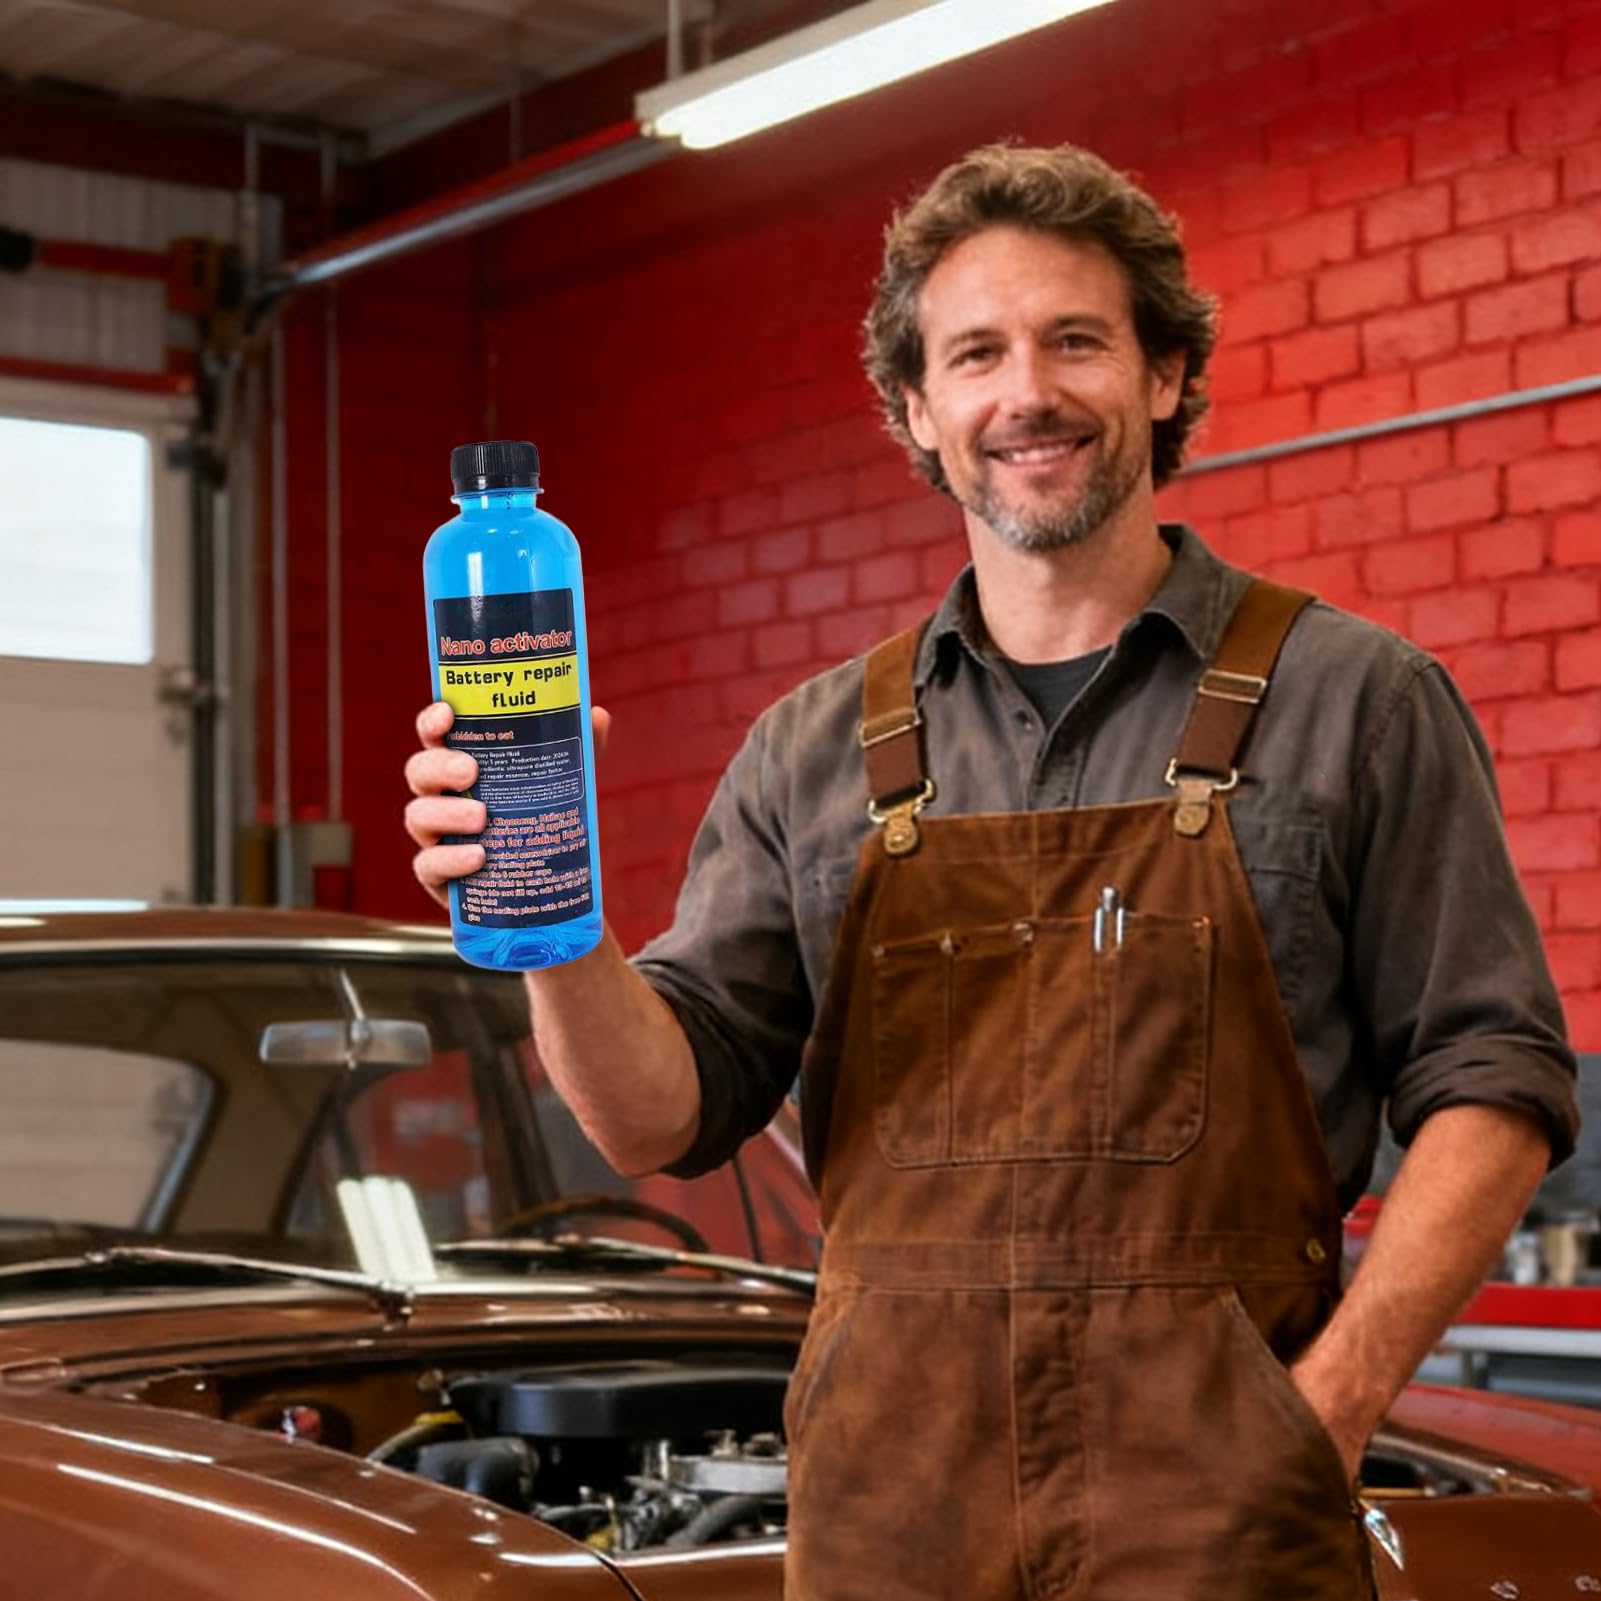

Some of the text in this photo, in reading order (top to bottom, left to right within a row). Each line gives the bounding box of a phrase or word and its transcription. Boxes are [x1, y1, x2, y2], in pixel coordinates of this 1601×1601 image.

[440, 629, 572, 656] Nano activator
[446, 662, 572, 686] Battery repair
[492, 691, 536, 708] fluid
[485, 731, 496, 741] to
[497, 730, 514, 740] eat
[489, 751, 505, 759] Repair
[506, 750, 520, 758] Fluid
[511, 756, 540, 764] Production
[506, 763, 533, 772] ultrapure
[534, 760, 555, 769] distilled
[531, 769, 548, 777] repair
[566, 806, 579, 817] and
[520, 826, 534, 834] are
[535, 823, 545, 833] all
[546, 817, 580, 832] applicable
[507, 836, 524, 847] for
[526, 834, 560, 846] adding
[562, 824, 585, 840] liquid
[526, 860, 546, 868] plate
[508, 870, 535, 878] rubber
[478, 880, 497, 888] repair
[525, 877, 543, 886] each
[515, 888, 525, 897] fill
[520, 905, 540, 915] plate
[540, 903, 557, 912] with
[557, 900, 569, 909] the
